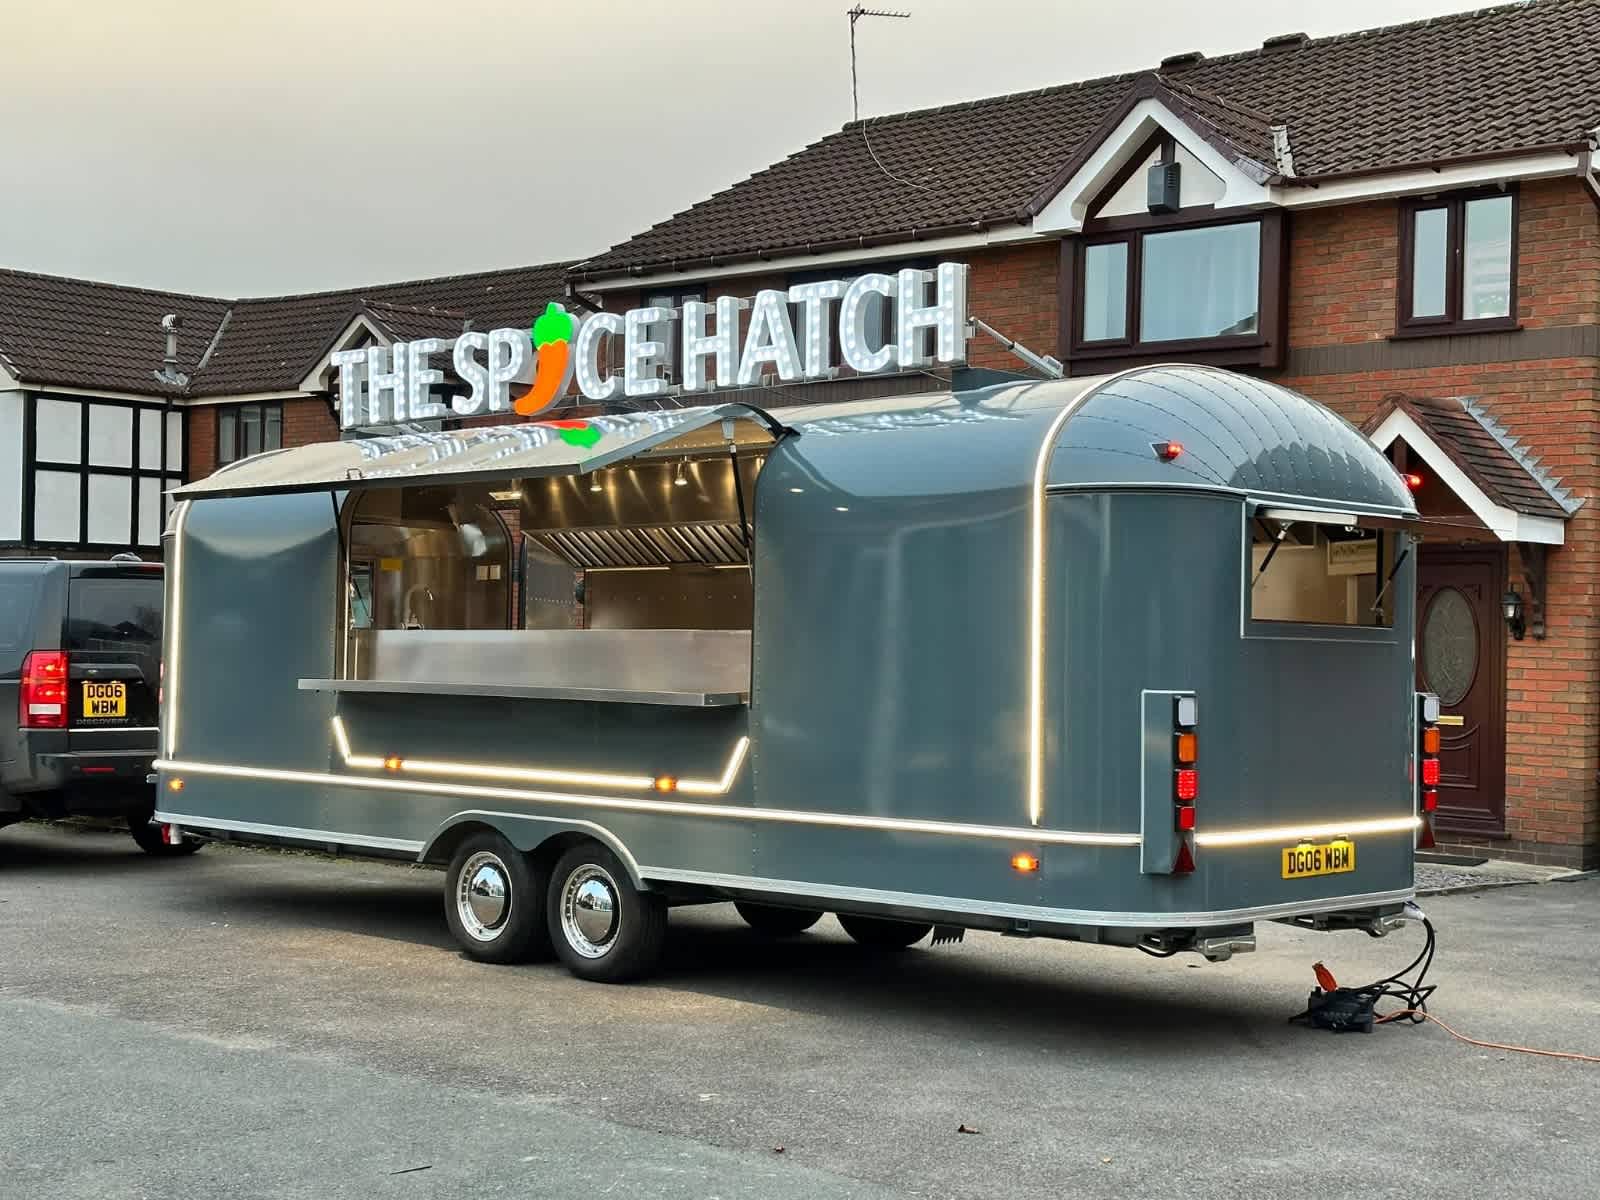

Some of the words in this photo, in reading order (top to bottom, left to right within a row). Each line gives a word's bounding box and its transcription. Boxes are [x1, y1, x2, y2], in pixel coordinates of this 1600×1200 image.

[330, 338, 445, 428] THE
[451, 302, 675, 418] SPICE
[682, 262, 969, 393] HATCH
[87, 685, 123, 698] DG06
[91, 700, 119, 714] WBM
[1287, 849, 1321, 874] DG06
[1324, 847, 1349, 870] WBM
